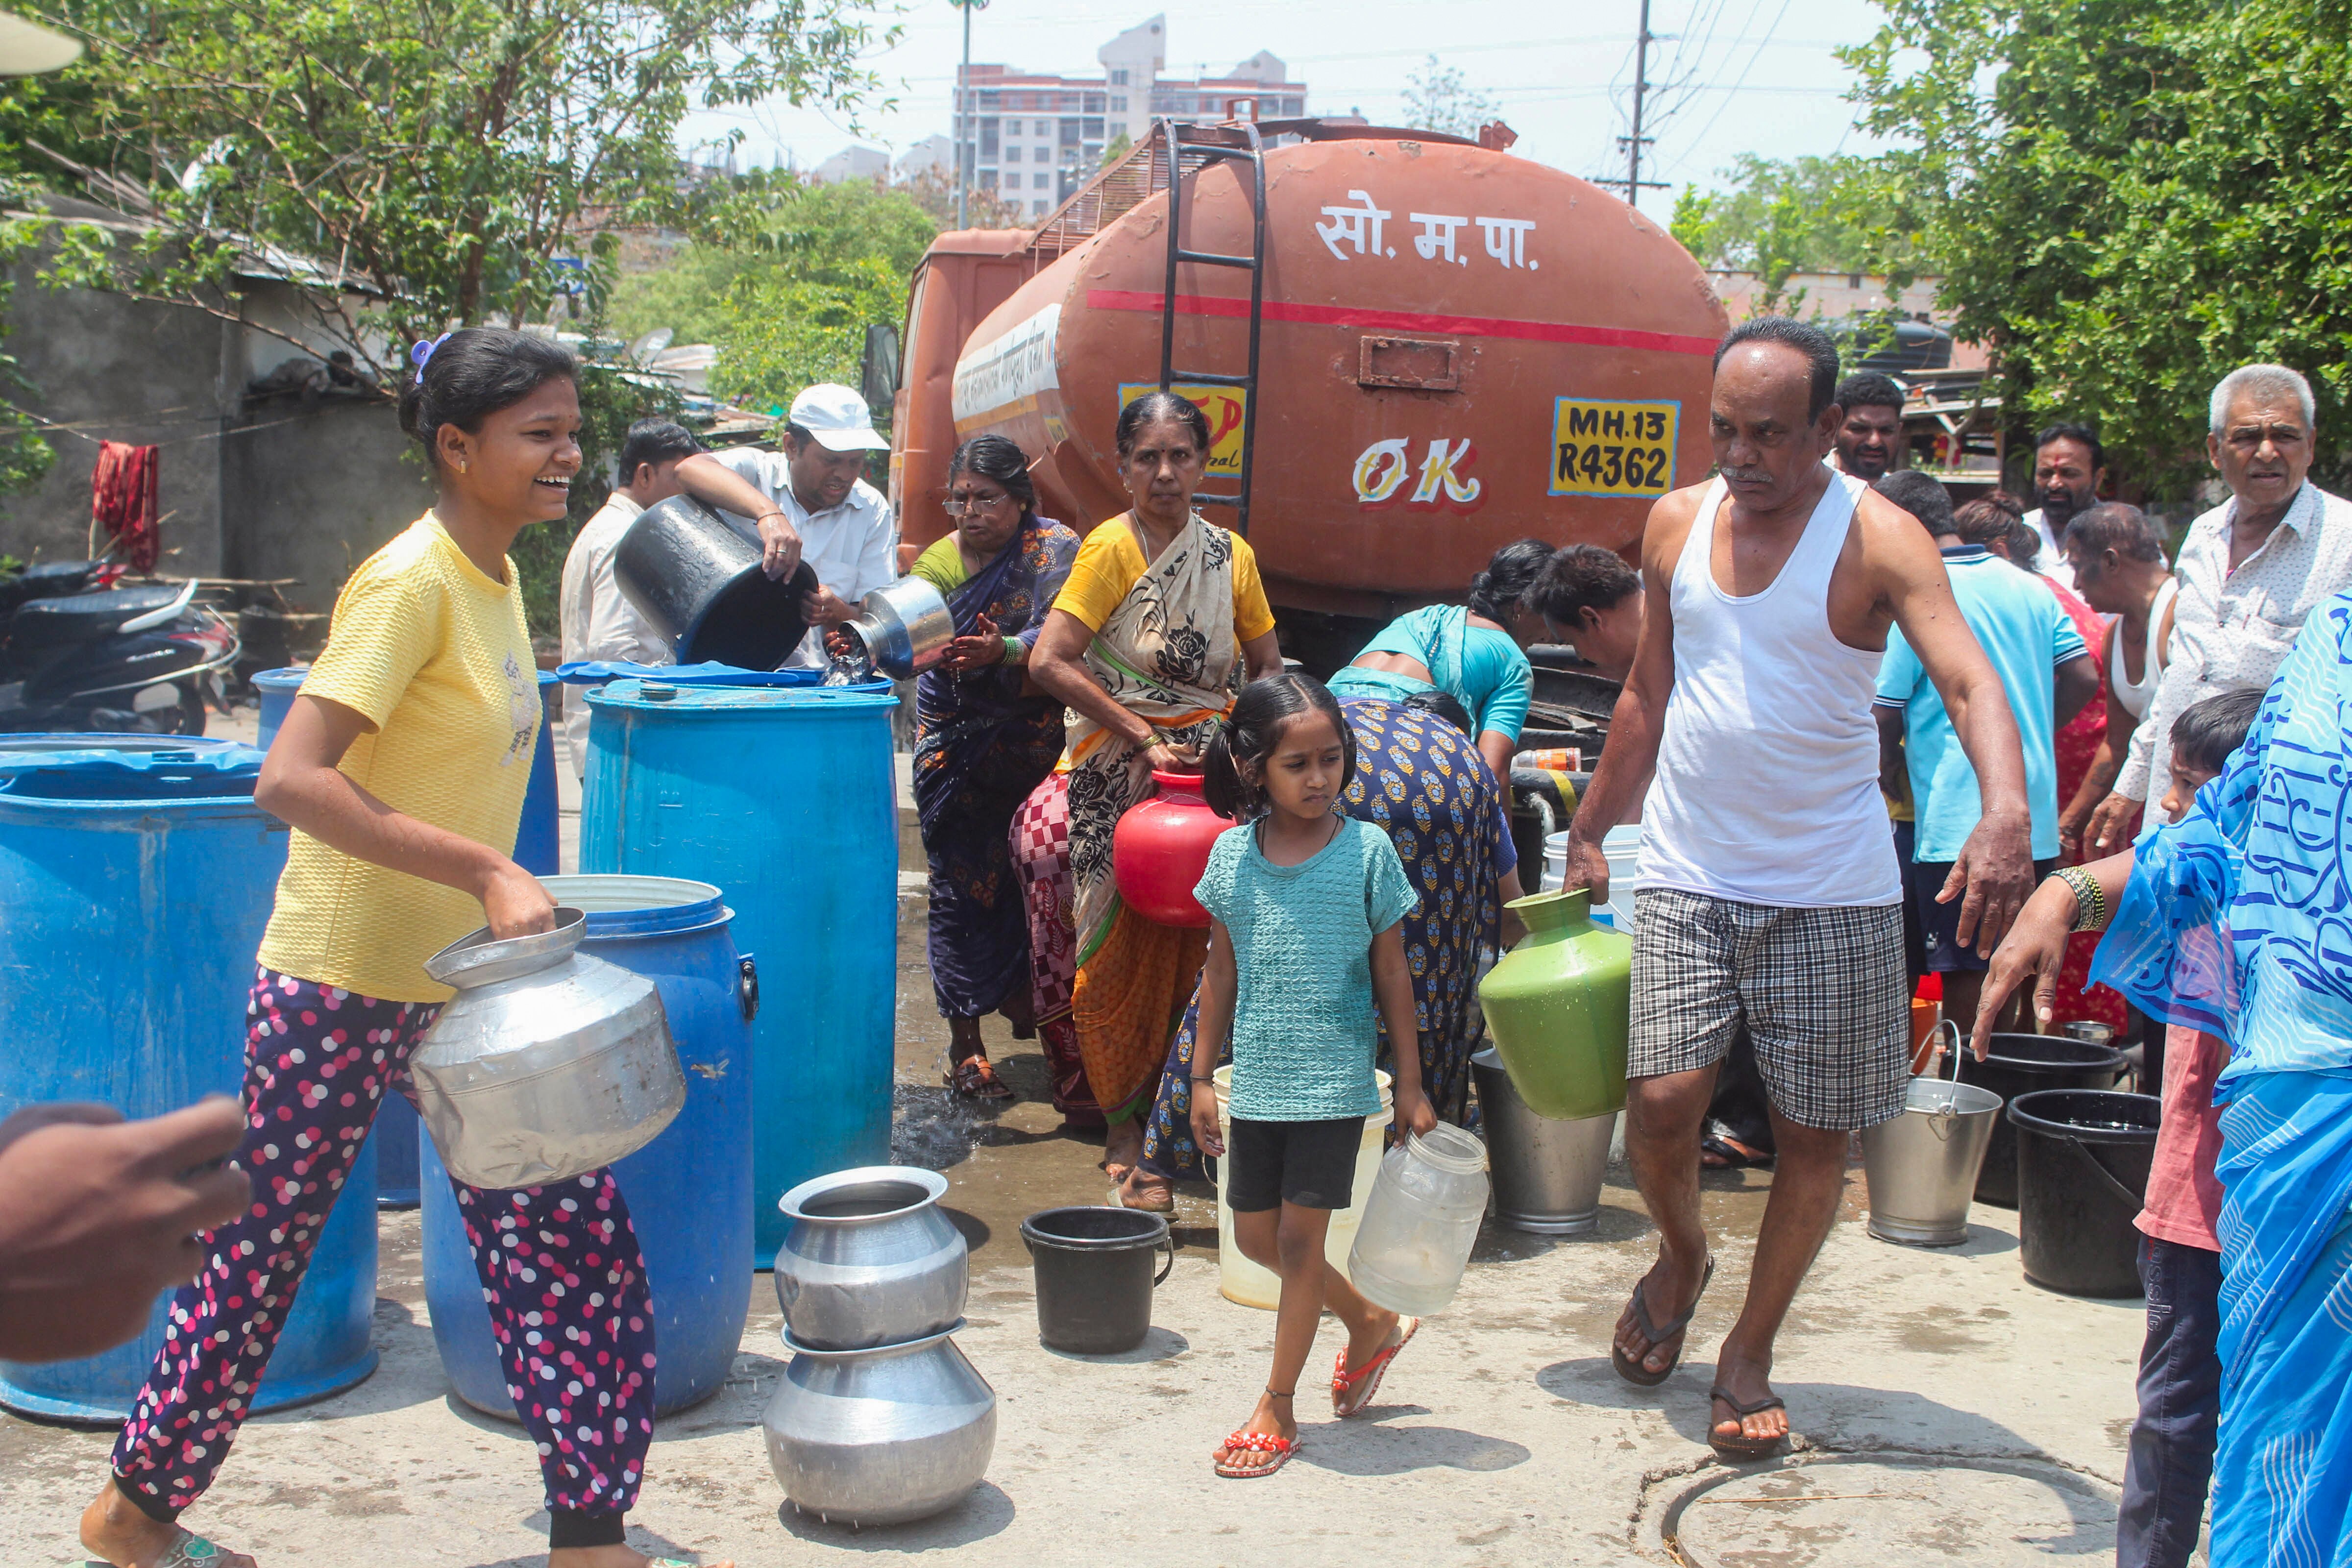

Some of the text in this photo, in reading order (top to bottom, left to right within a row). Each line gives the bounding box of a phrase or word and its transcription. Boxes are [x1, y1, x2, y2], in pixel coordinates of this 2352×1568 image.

[1315, 189, 1539, 271] सो. म. पा.
[1569, 407, 1666, 441] MH.13
[1352, 435, 1481, 503] OK
